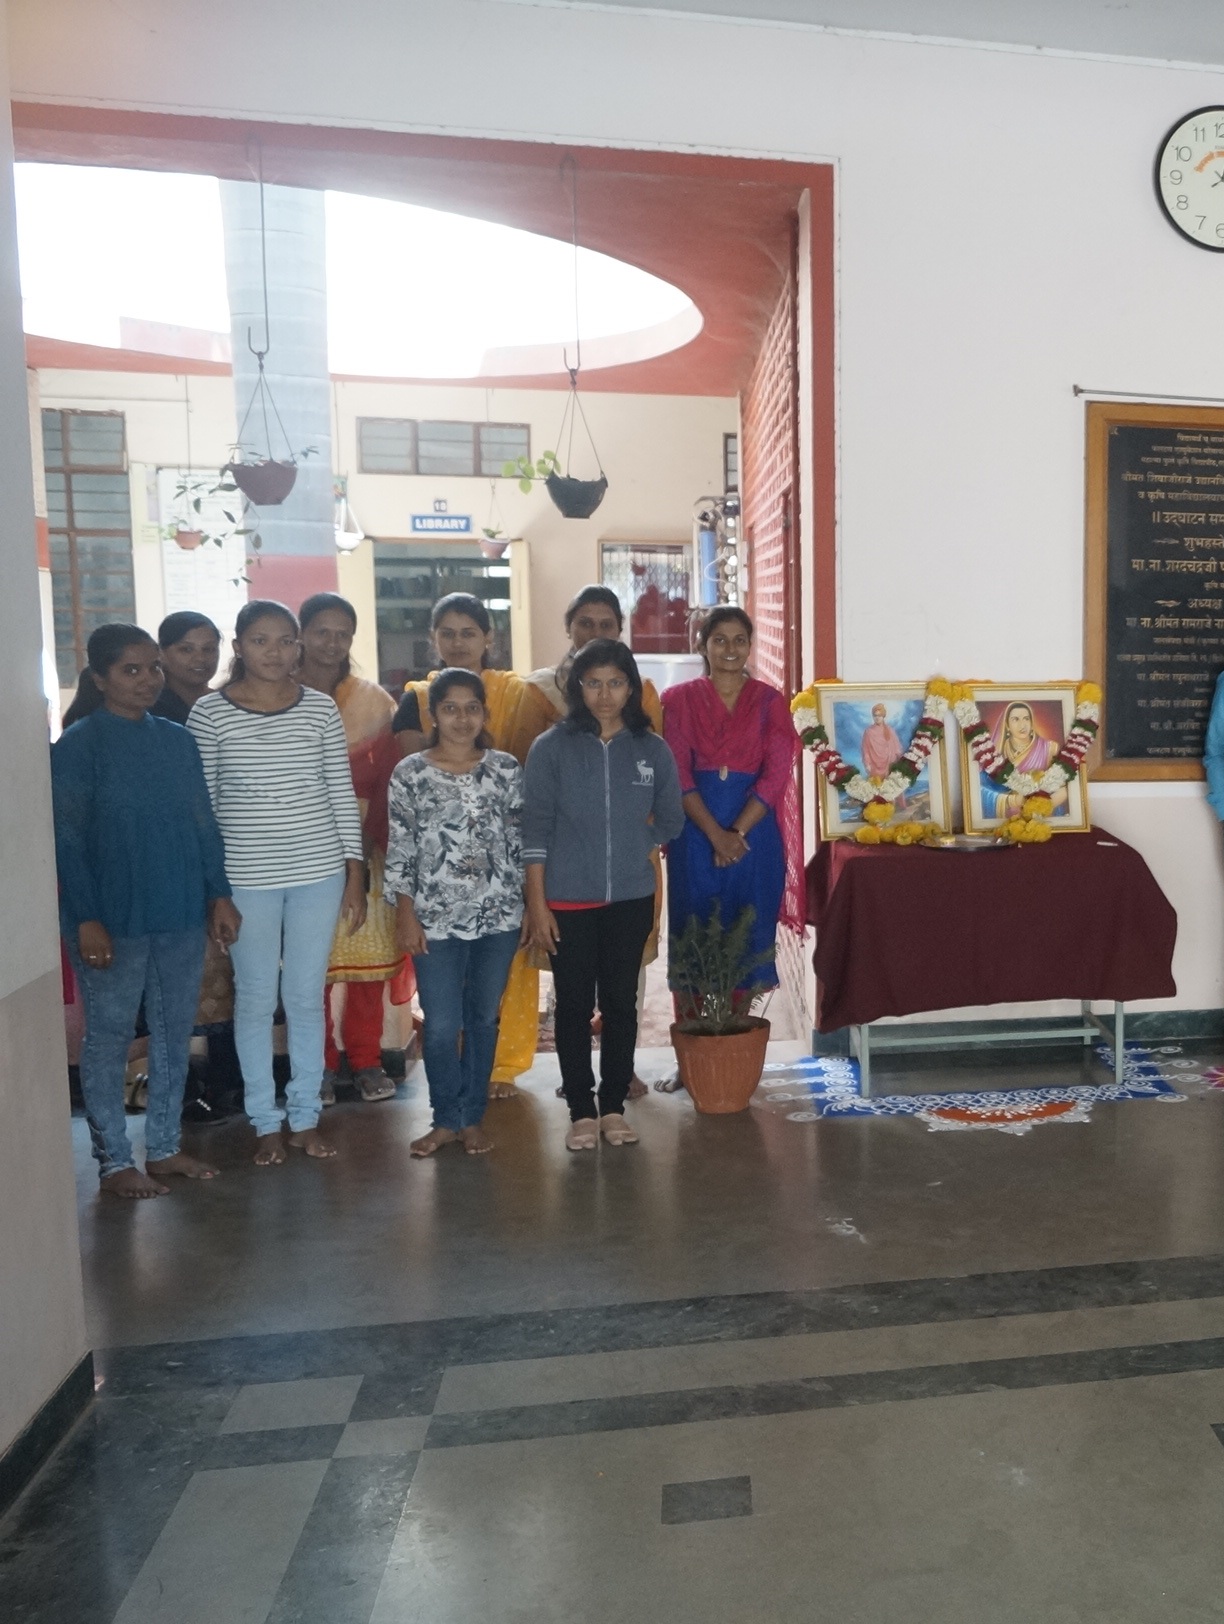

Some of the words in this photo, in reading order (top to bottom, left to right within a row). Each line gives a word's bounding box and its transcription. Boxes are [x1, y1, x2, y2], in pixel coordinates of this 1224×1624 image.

[1193, 126, 1206, 142] 11
[1174, 145, 1192, 162] 10
[1169, 169, 1183, 186] 9
[1176, 194, 1189, 211] 8
[1195, 215, 1207, 230] 7
[415, 518, 467, 530] LIBRARY
[1187, 598, 1223, 611] अध्यक्ष
